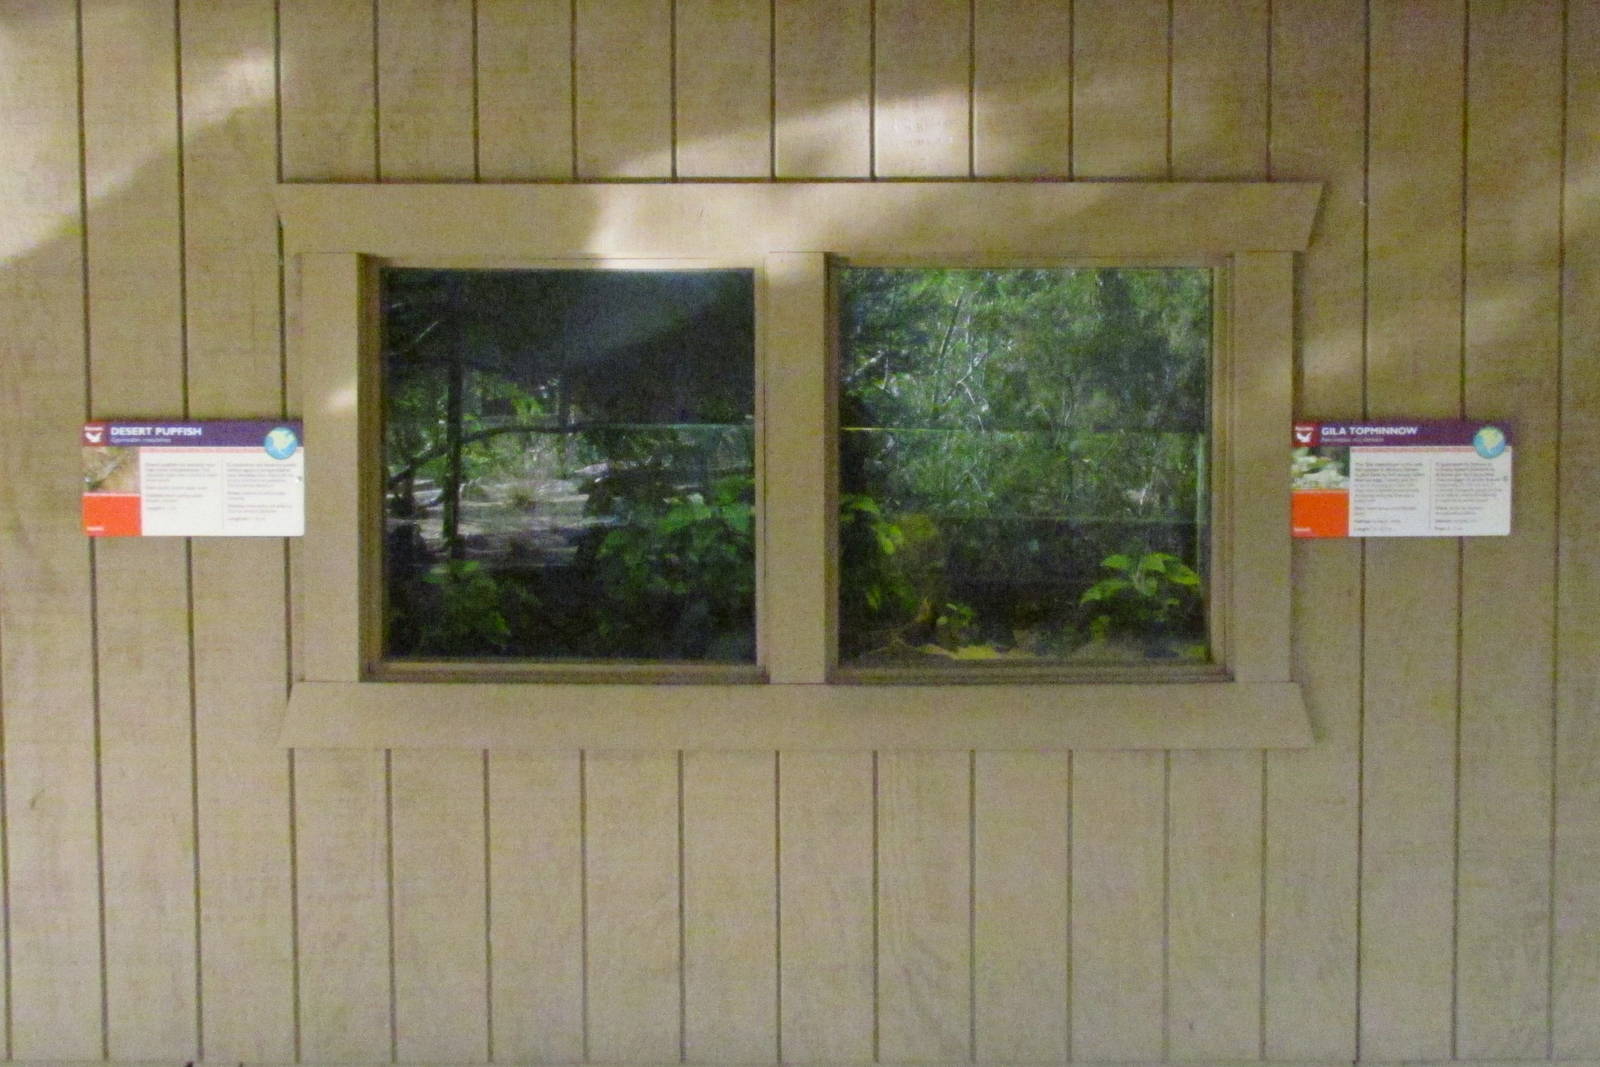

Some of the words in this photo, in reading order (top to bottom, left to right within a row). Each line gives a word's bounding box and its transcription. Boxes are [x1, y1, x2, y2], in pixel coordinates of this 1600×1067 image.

[110, 426, 153, 436] DESERT
[155, 426, 202, 436] PUPFISH
[1321, 426, 1346, 435] GILA
[1349, 426, 1418, 435] TOPMINNOW
